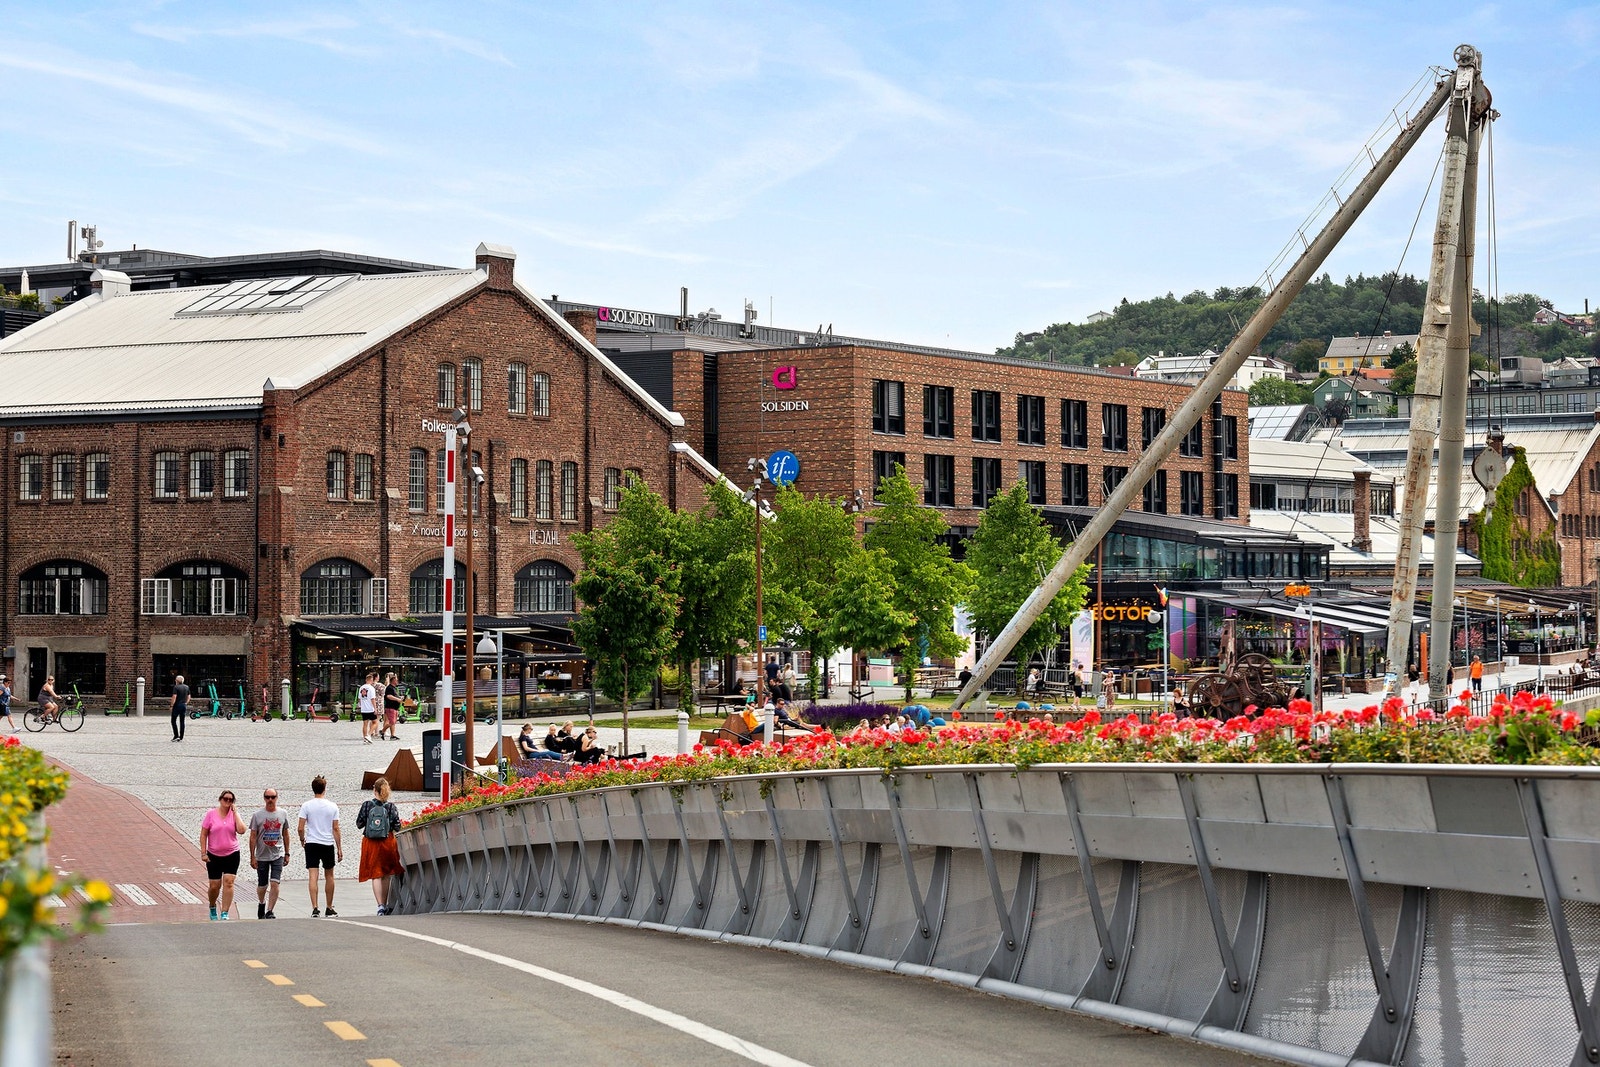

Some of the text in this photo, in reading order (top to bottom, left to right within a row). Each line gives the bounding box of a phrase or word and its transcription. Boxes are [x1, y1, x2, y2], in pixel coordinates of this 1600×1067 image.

[611, 309, 655, 328] SOLSIDEN
[761, 400, 809, 412] SOLSIDEN
[420, 527, 440, 536] nova
[1088, 602, 1153, 621] ÉCTOR
